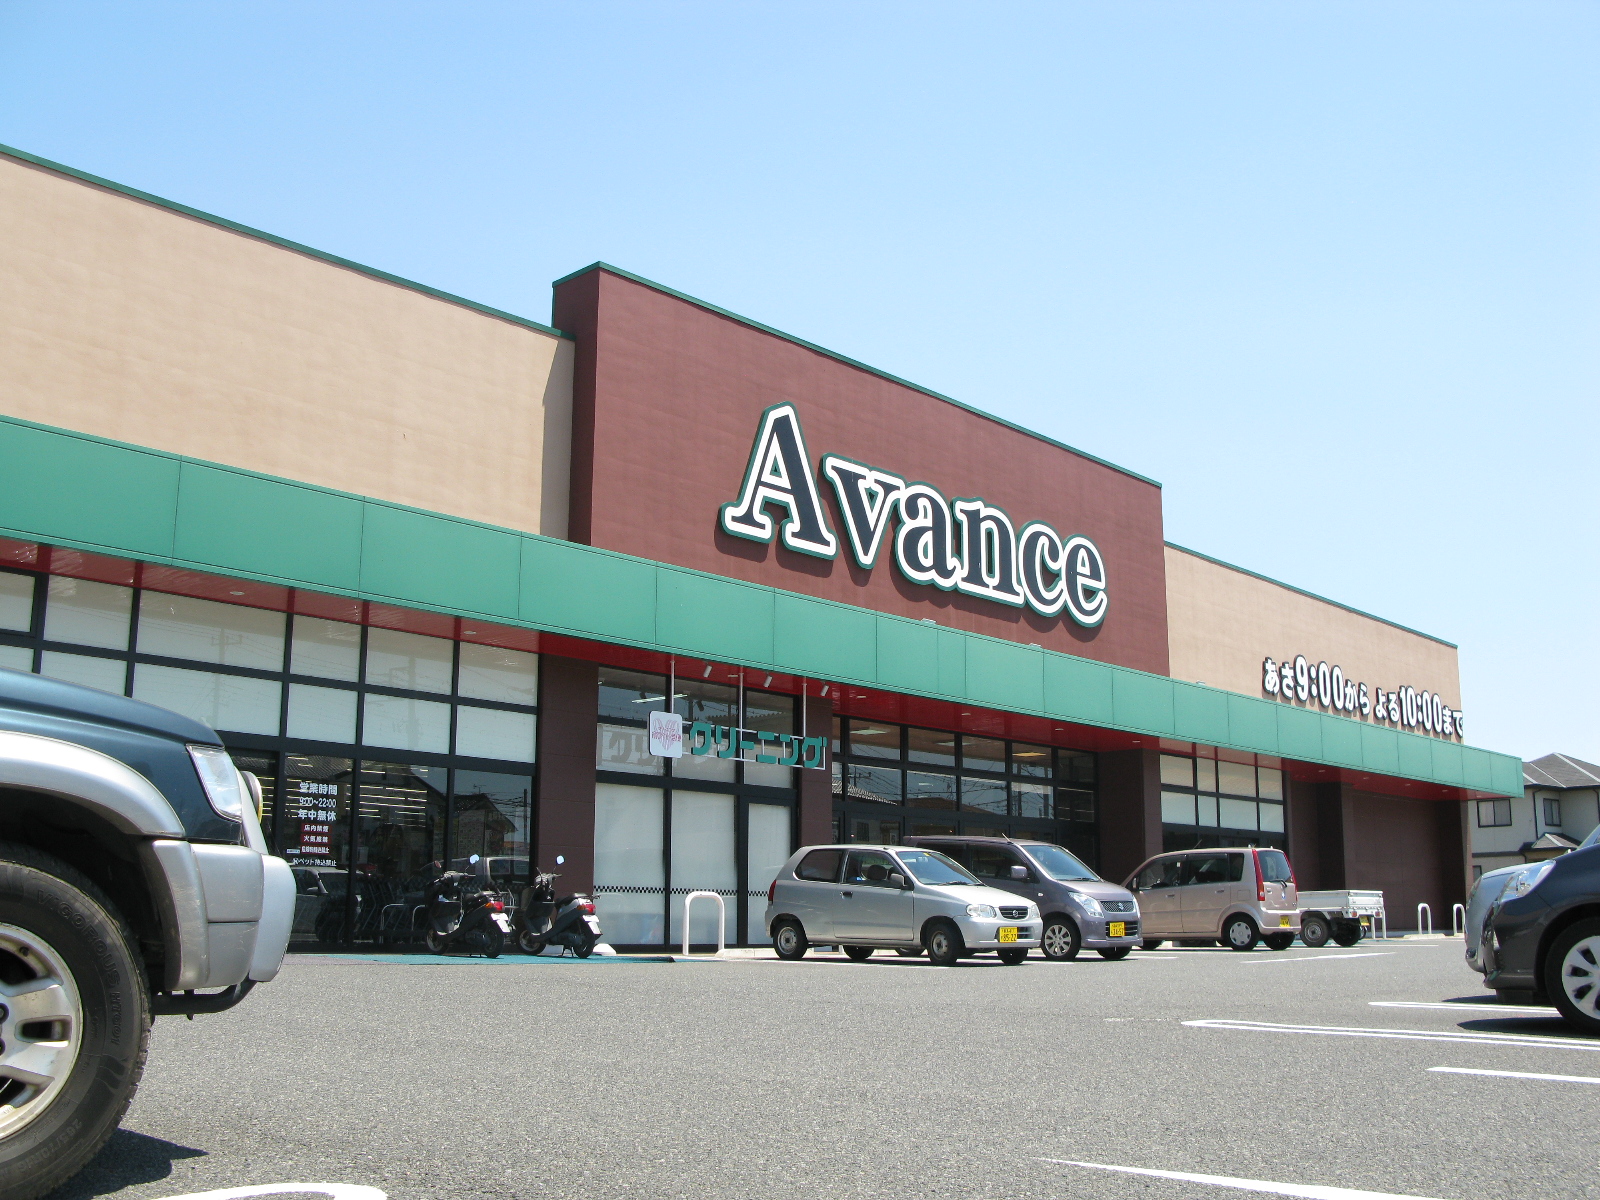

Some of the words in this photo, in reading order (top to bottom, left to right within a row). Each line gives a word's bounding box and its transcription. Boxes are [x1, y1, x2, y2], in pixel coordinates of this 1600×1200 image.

[721, 402, 1108, 627] Avance
[1263, 654, 1370, 716] あさ9:00から
[1374, 685, 1464, 738] よる10:00まで
[690, 722, 828, 768] クリーニング
[299, 781, 338, 796] 営業時間
[298, 809, 337, 821] 年中無休
